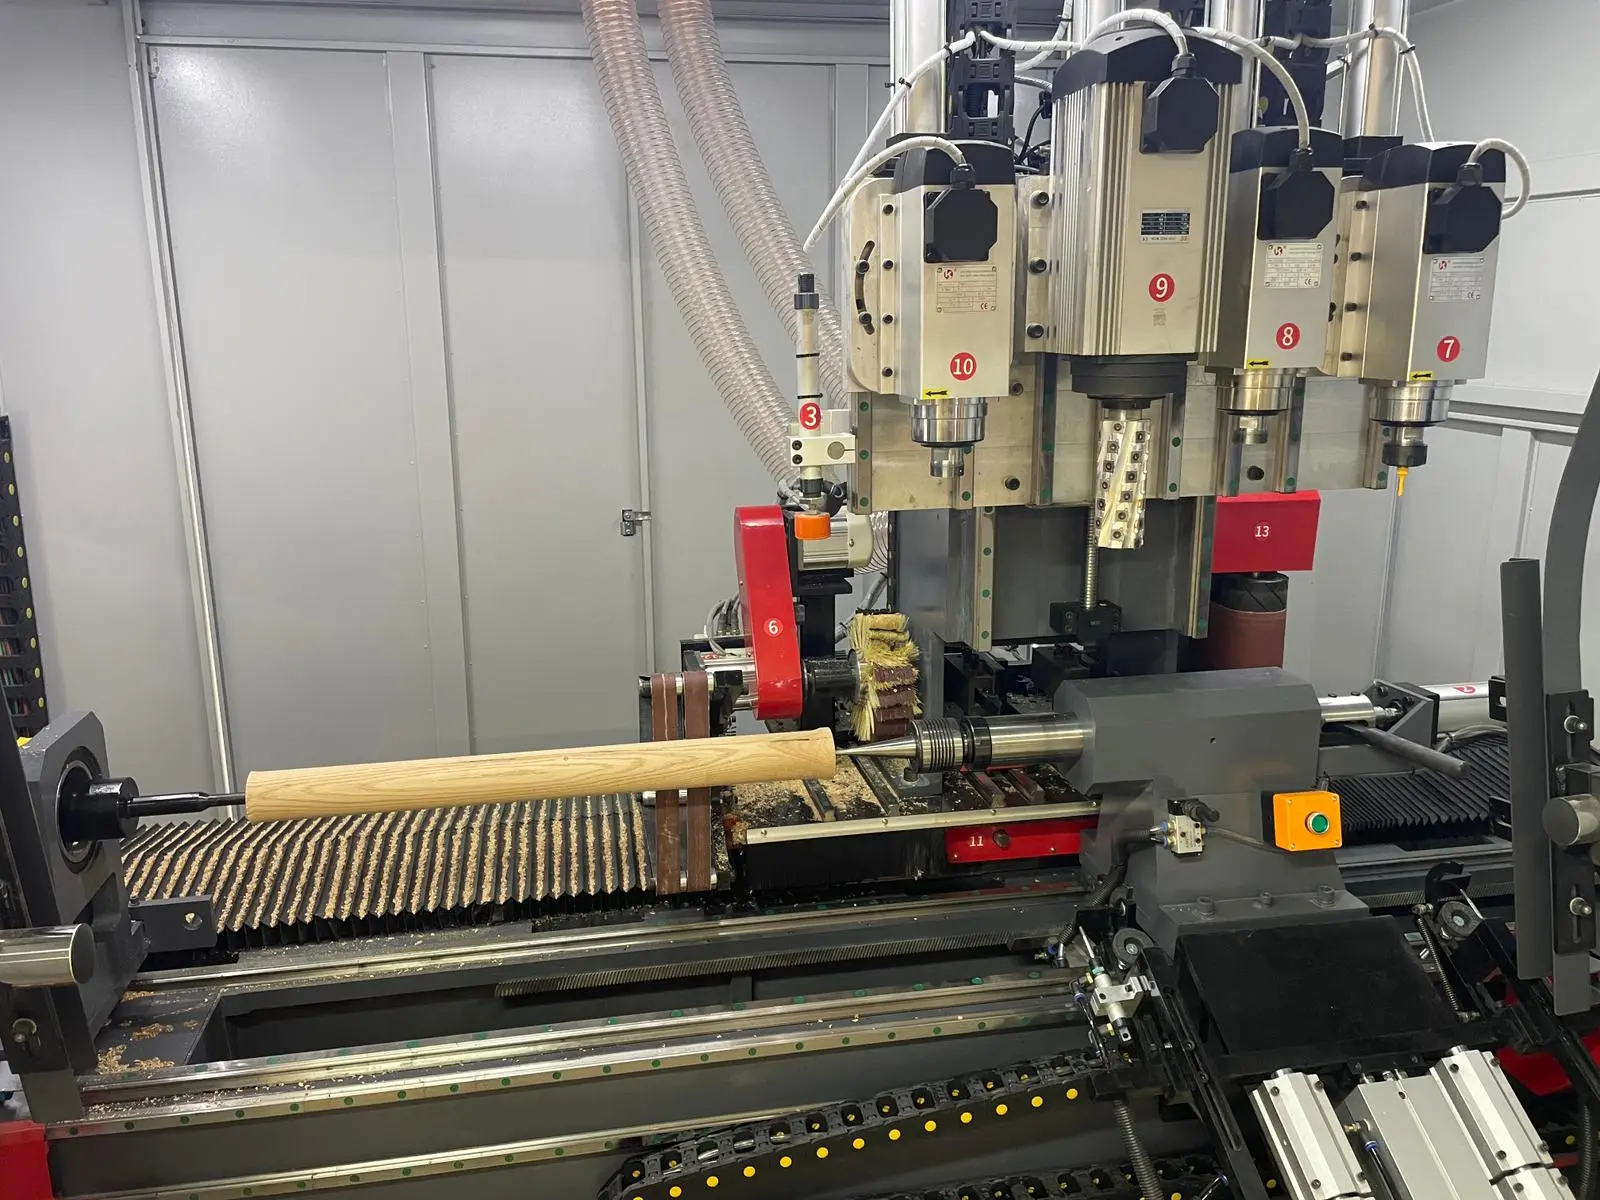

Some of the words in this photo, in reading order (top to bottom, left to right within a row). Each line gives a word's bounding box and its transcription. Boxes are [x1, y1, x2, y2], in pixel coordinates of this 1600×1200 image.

[1155, 277, 1168, 299] 9
[1282, 326, 1294, 346] 8
[1443, 339, 1455, 359] 7
[953, 358, 974, 375] 10
[804, 405, 817, 427] 3
[1255, 525, 1270, 538] 13
[768, 619, 779, 635] 6
[969, 835, 984, 847] 11
